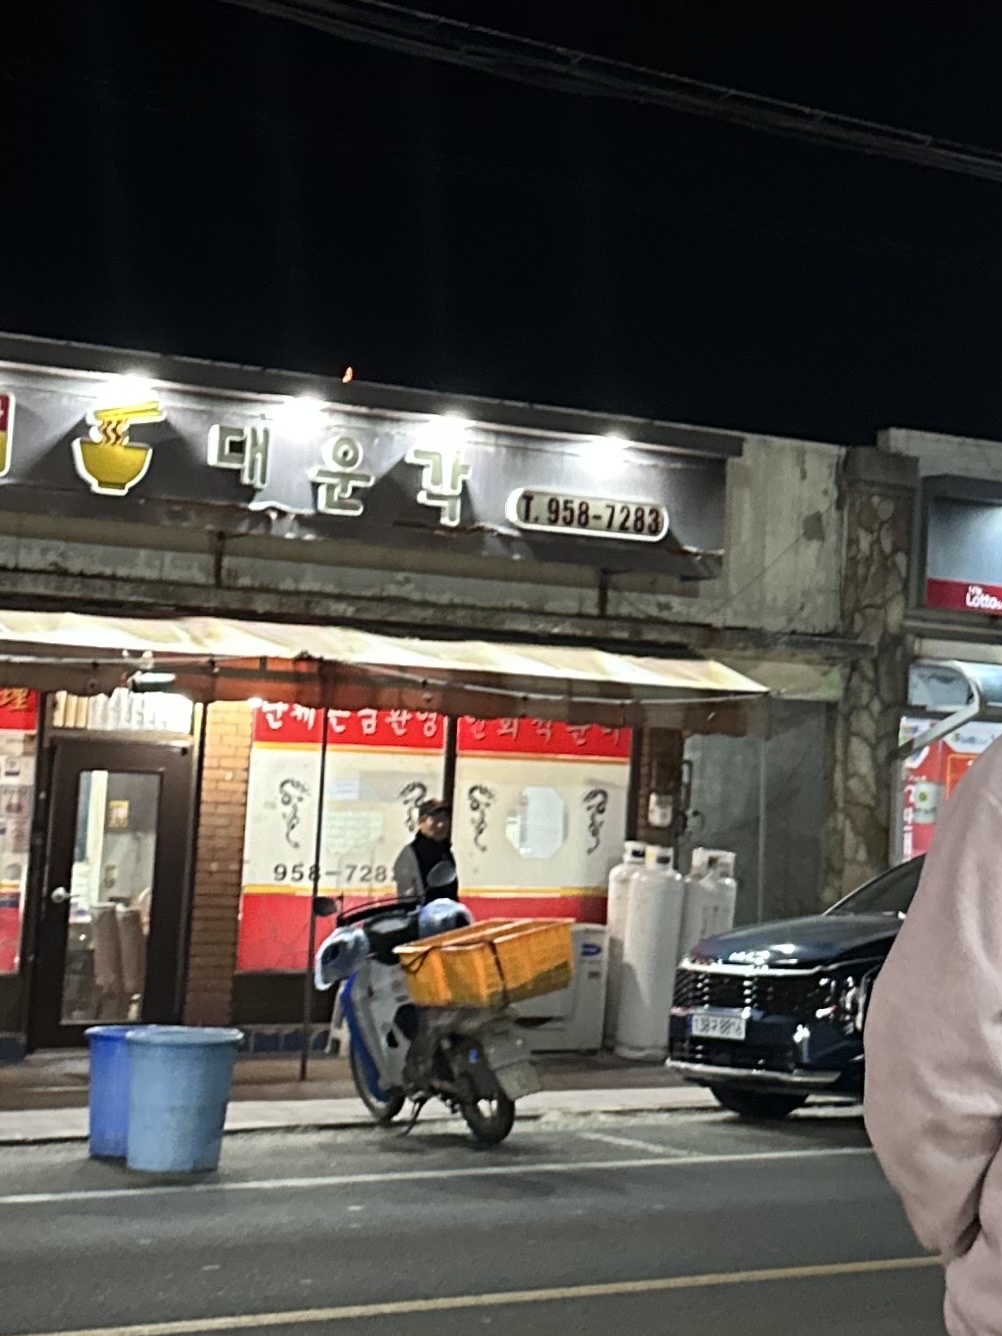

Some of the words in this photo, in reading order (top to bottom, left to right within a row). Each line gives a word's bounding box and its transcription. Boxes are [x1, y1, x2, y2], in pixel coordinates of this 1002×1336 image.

[208, 423, 471, 526] 대운각
[522, 494, 539, 522] T.
[547, 498, 661, 535] 958-7283
[273, 862, 394, 882] 958-728
